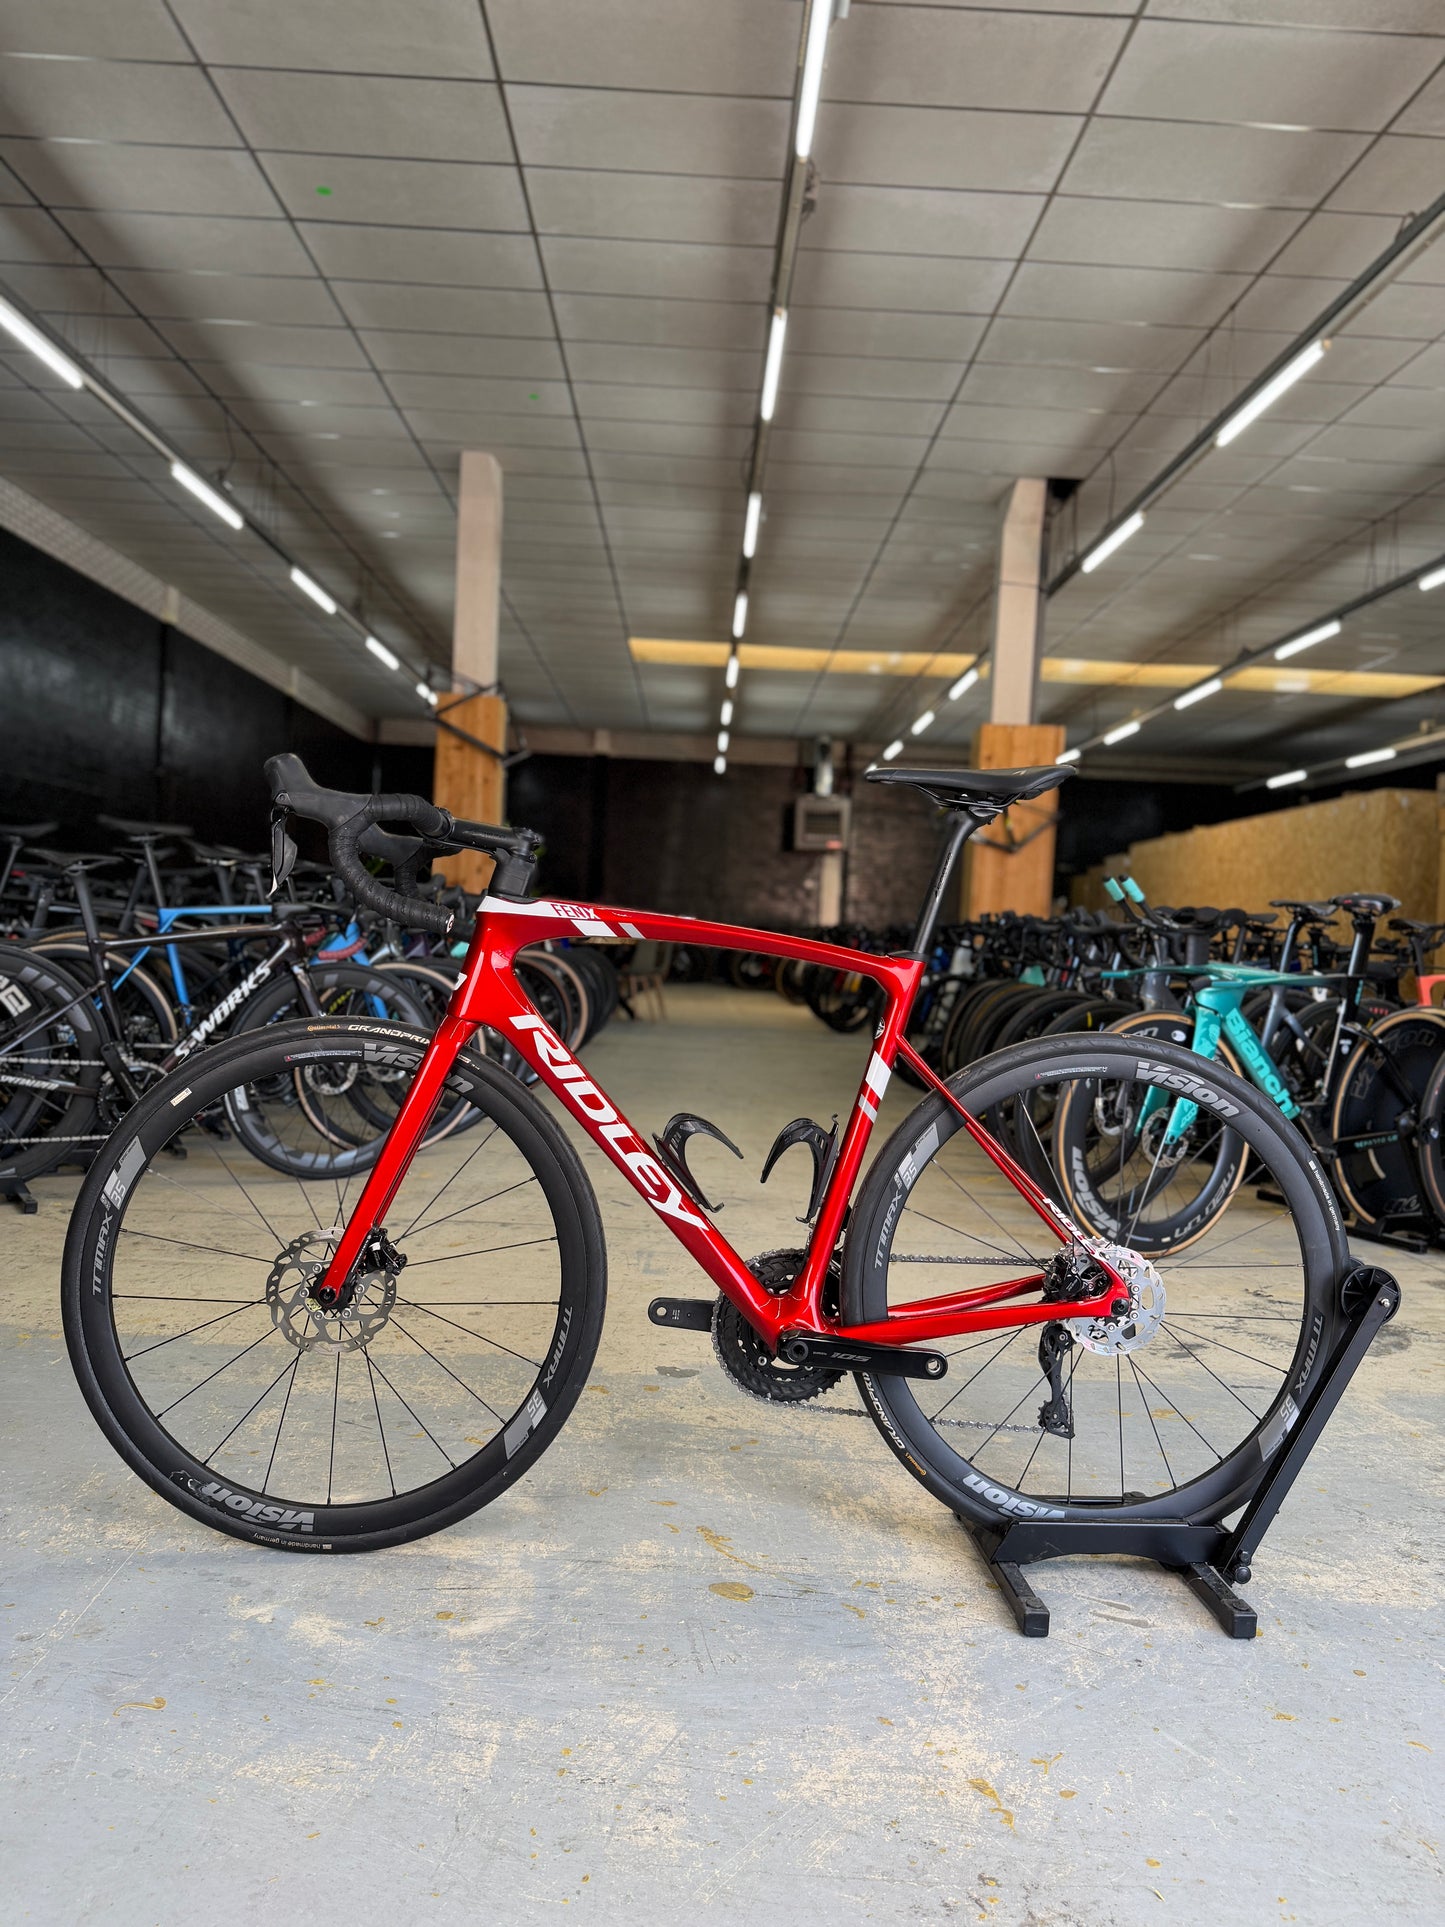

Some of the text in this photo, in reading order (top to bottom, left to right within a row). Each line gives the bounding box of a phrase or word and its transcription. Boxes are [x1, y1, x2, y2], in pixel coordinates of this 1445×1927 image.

[550, 903, 600, 920] FENIX
[1225, 1008, 1300, 1120] Bianchi
[1135, 1061, 1240, 1118] Vision
[508, 1014, 709, 1231] RIDLEY
[903, 1162, 917, 1186] 35
[1314, 1169, 1330, 1200] handmade
[110, 1180, 126, 1206] 35
[1072, 1146, 1121, 1238] Vision
[831, 1351, 872, 1362] 105
[527, 1392, 543, 1418] 35
[1280, 1397, 1295, 1422] 35
[200, 1481, 315, 1532] Vision
[962, 1473, 1065, 1519] Vision
[253, 1532, 280, 1544] germany
[288, 1541, 321, 1549] handmade
